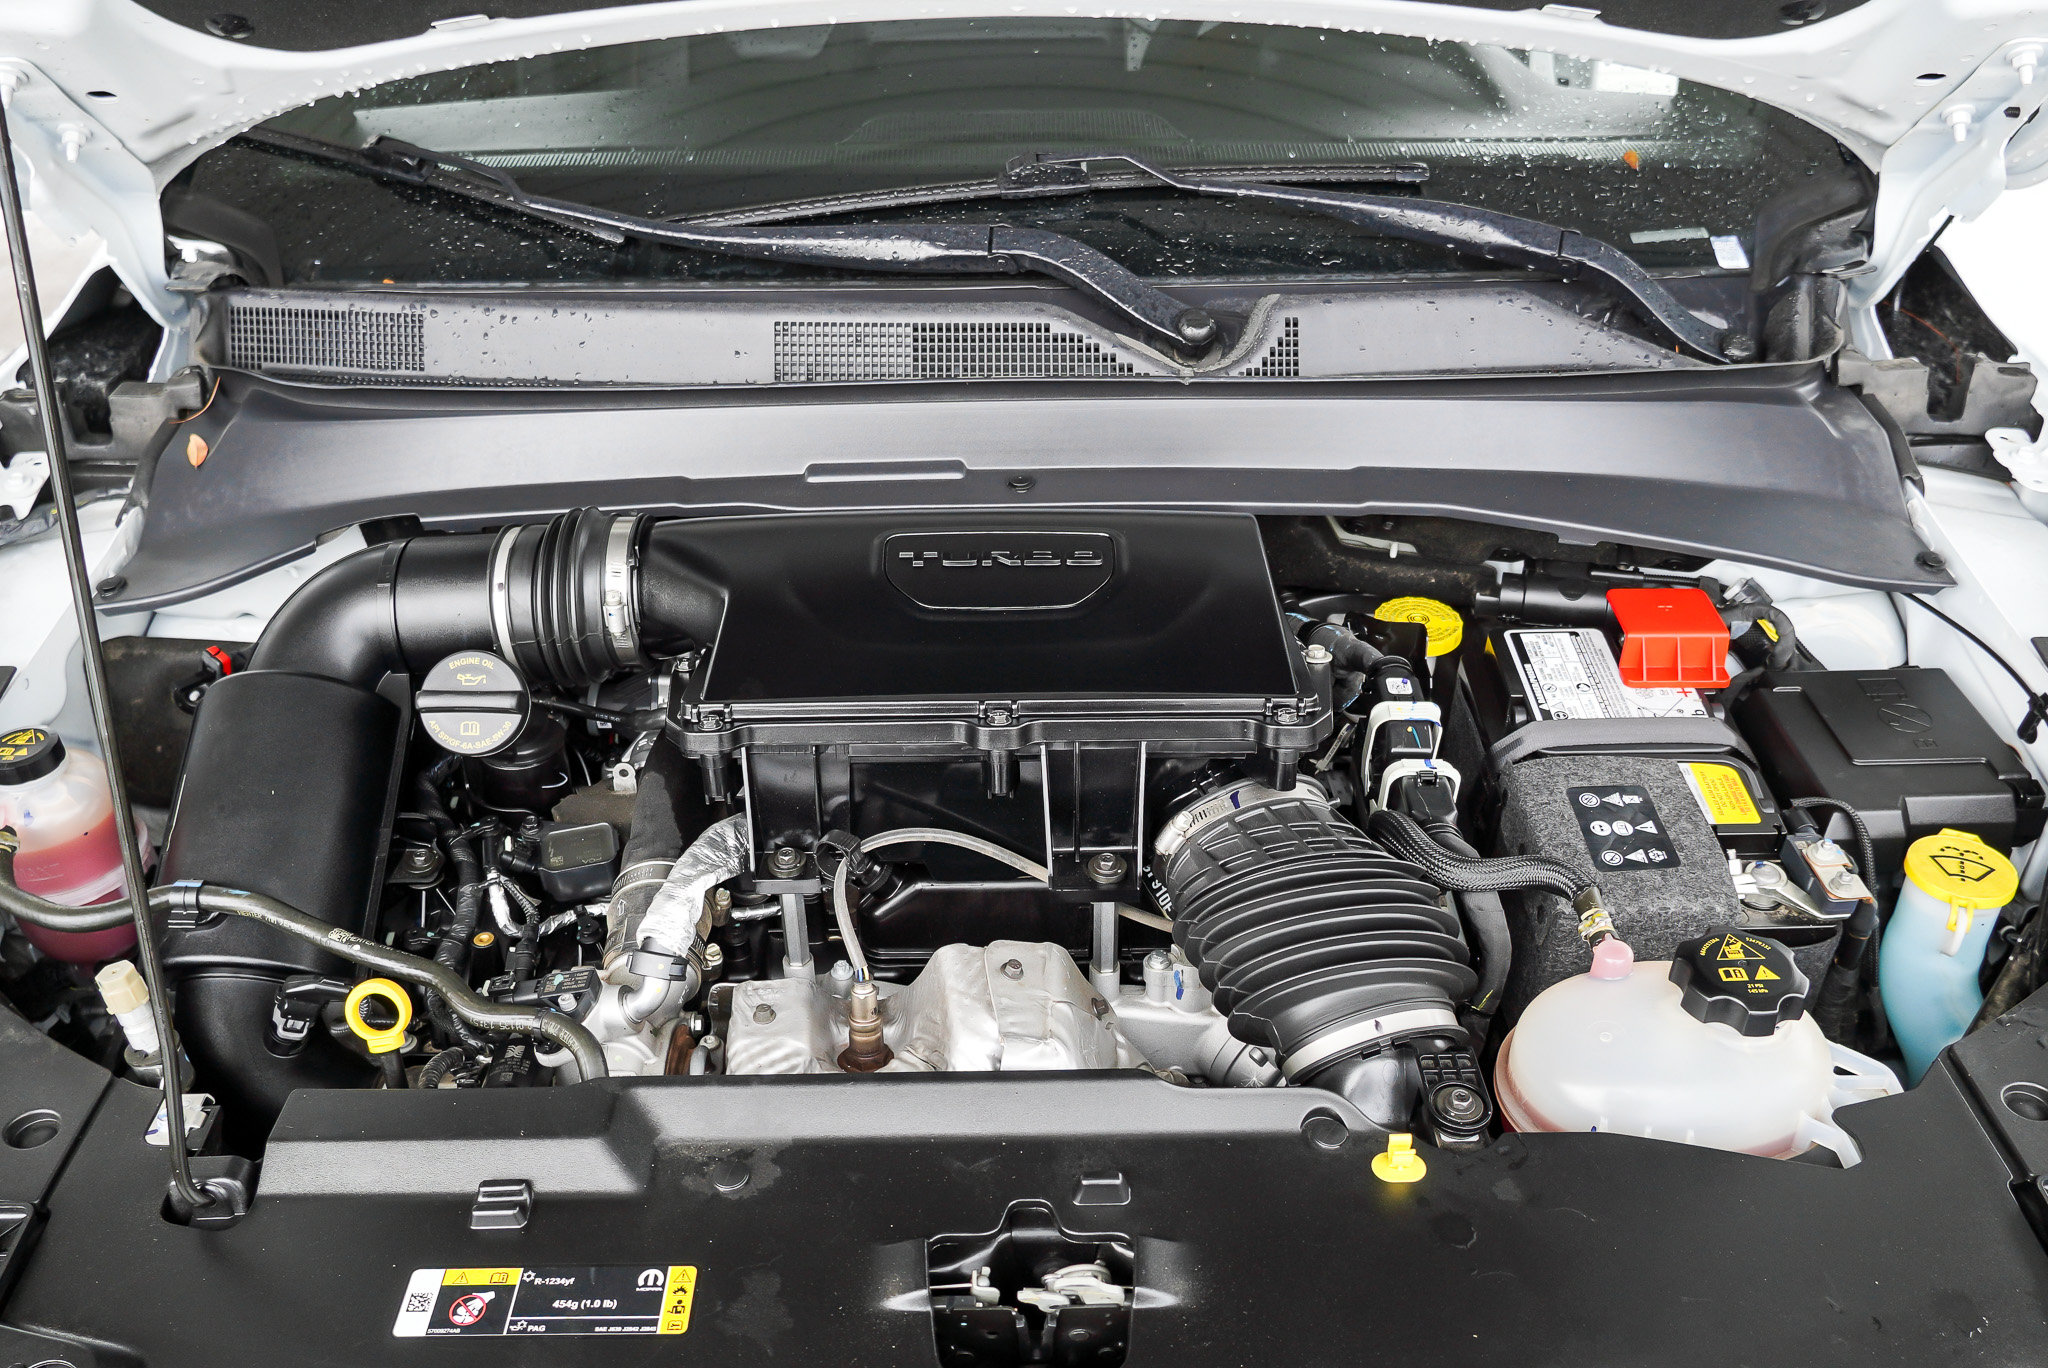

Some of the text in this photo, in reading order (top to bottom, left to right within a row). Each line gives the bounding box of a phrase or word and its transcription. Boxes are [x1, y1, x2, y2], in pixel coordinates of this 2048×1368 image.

[899, 551, 1103, 567] TURBO
[448, 657, 495, 670] ENGINE OIL
[428, 720, 441, 734] API
[533, 1277, 576, 1287] R-1234yf
[552, 1298, 618, 1310] 454g (1.0 lb)
[526, 1324, 546, 1332] PAG
